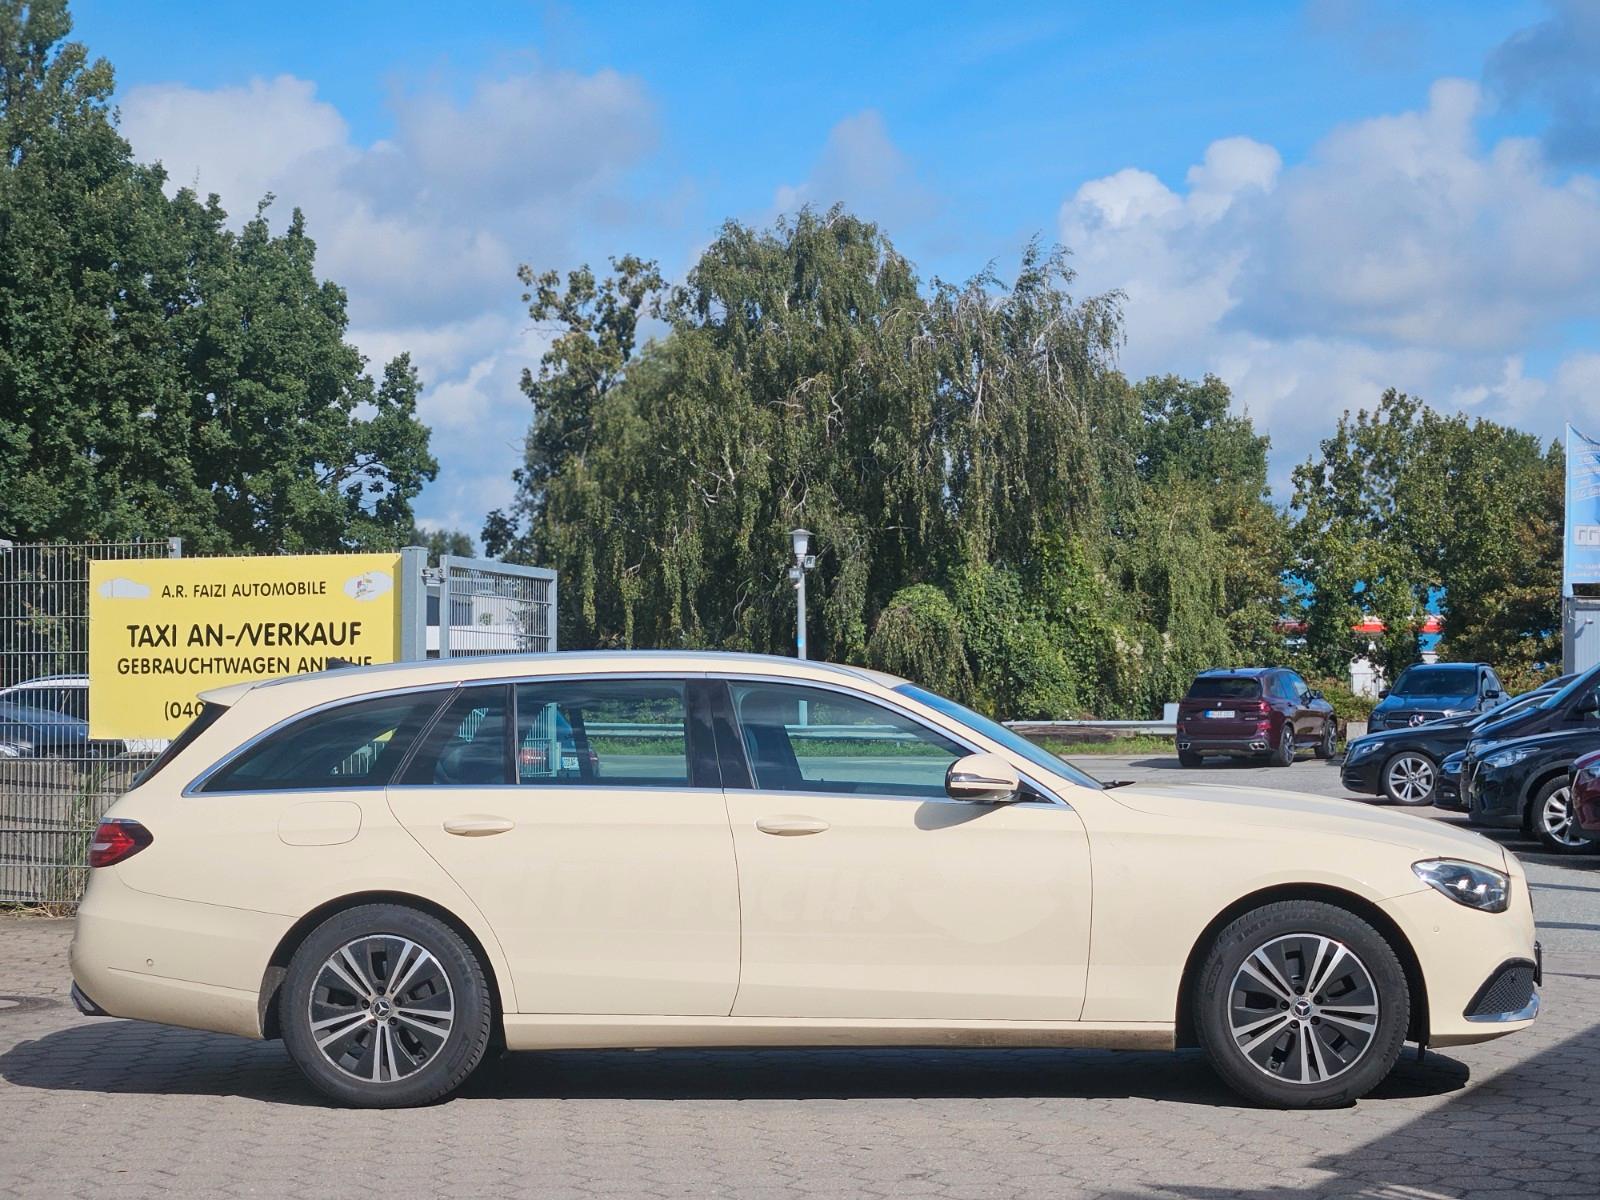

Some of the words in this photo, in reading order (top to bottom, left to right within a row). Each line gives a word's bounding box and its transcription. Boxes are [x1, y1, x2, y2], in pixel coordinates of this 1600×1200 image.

[161, 584, 188, 598] A.R.
[193, 583, 226, 598] FAIZI
[231, 581, 327, 597] AUTOMOBILE
[126, 623, 178, 648] TAXI
[186, 621, 362, 648] AN-/VERKAUF
[117, 657, 290, 675] GEBRAUCHTWAGEN
